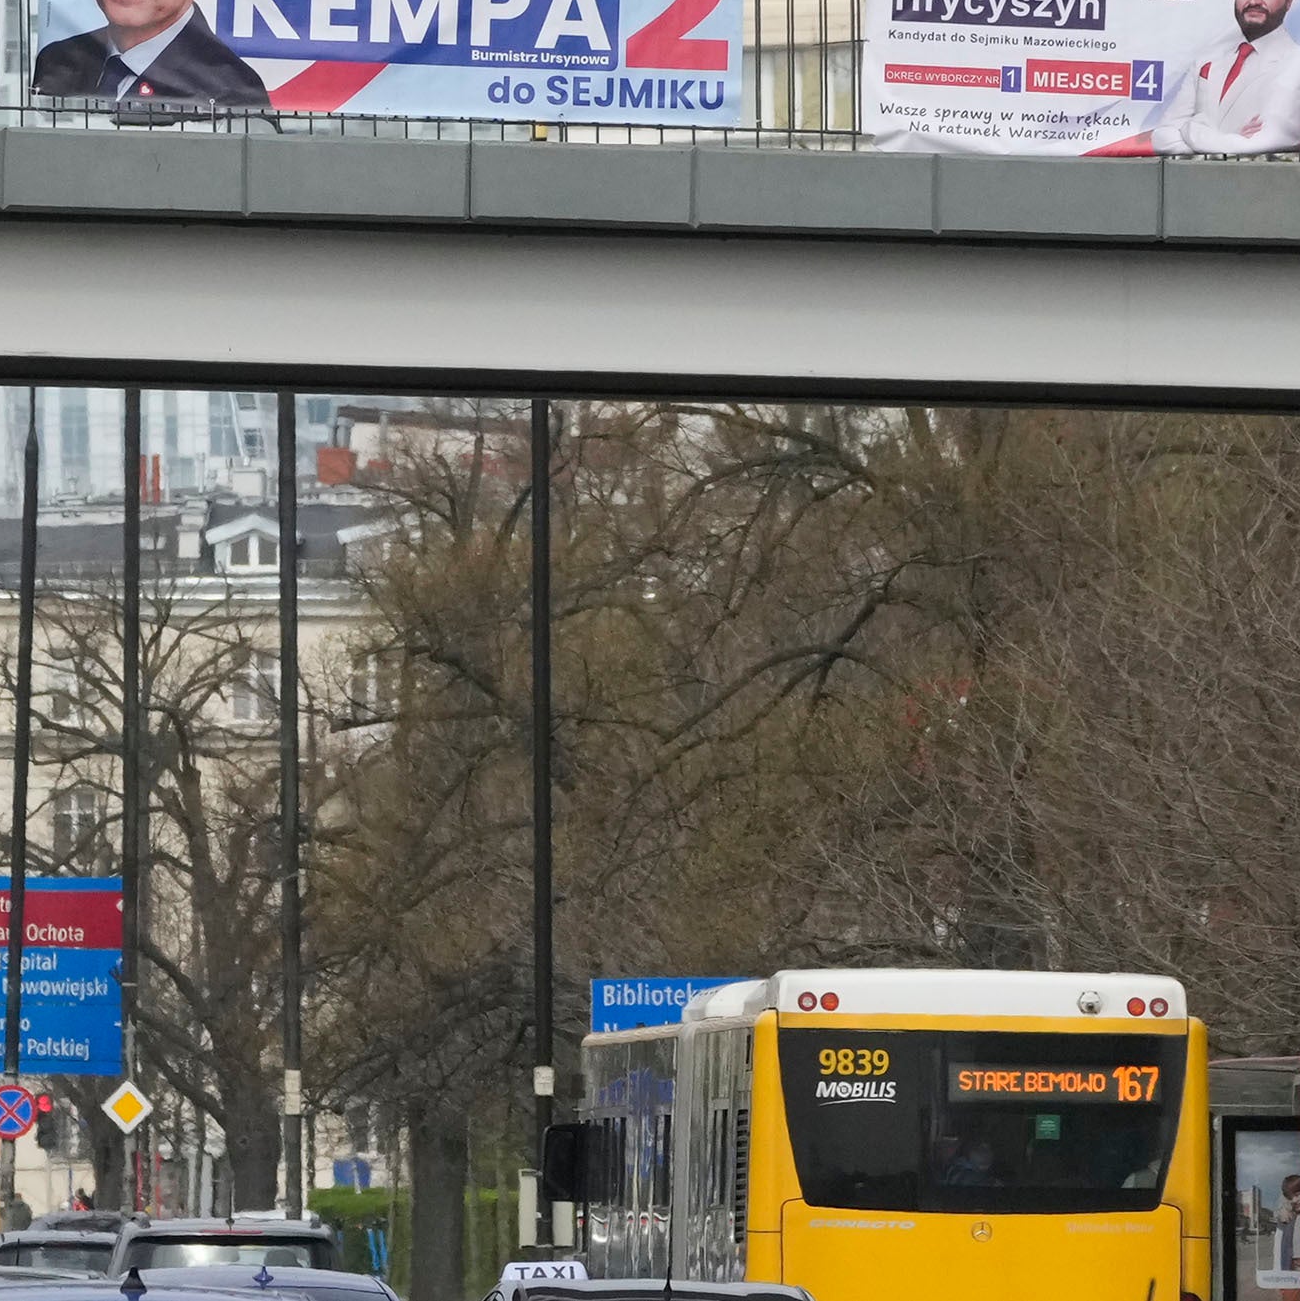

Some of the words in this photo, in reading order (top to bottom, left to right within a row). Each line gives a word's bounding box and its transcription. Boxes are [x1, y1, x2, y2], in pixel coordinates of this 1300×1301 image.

[888, 28, 947, 44] Kandydat
[950, 32, 966, 43] do
[970, 32, 1019, 47] Sejmiku
[1023, 35, 1117, 51] Mazowieckiego
[471, 48, 538, 65] Burmistrz
[541, 51, 610, 67] Ursynowa
[886, 69, 922, 83] OKRĘG
[923, 71, 985, 85] WYBORCZY
[986, 74, 1000, 85] NR
[1007, 68, 1016, 88] 1
[1033, 71, 1123, 91] MIEJSCE
[1135, 63, 1158, 96] 4
[487, 74, 537, 105] do
[546, 76, 726, 111] SEJMIKU
[880, 103, 927, 118] Wasze
[934, 108, 994, 125] sprawy
[1001, 111, 1014, 121] w
[1021, 107, 1071, 124] moich
[1076, 110, 1131, 129] rękach
[909, 119, 931, 133] Na
[938, 121, 1001, 138] ratunek
[1008, 126, 1099, 142] Warszawie!
[27, 922, 85, 942] Ochota
[603, 982, 698, 1007] Bibliotek
[28, 1037, 90, 1061] Polskiej
[819, 1048, 890, 1076] 9839
[816, 1080, 897, 1098] MOBILIS
[958, 1070, 1022, 1092] STARE
[1024, 1072, 1107, 1093] BEMOWO
[1112, 1065, 1160, 1102] 167
[515, 1266, 575, 1279] TAXI
